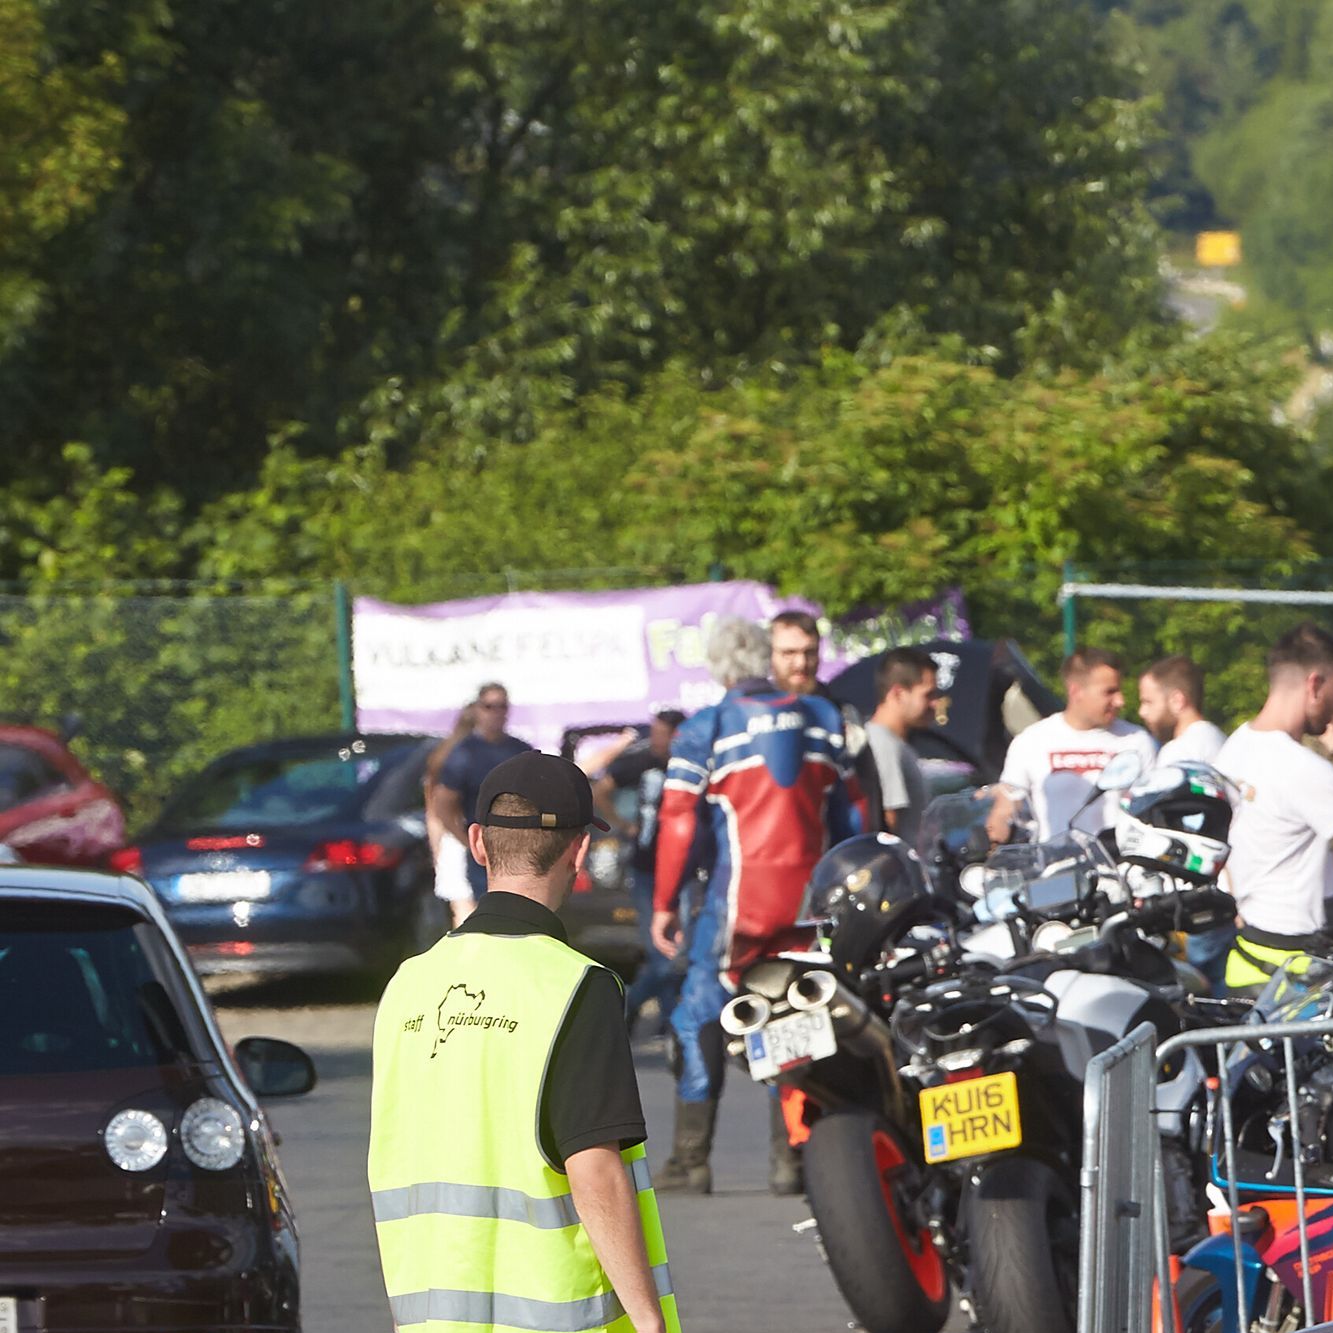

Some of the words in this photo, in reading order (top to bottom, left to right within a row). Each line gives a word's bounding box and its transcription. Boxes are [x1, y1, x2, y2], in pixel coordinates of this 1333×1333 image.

[403, 1013, 425, 1033] staff
[447, 1012, 519, 1034] nürburgring
[931, 1081, 1005, 1120] KU16
[948, 1110, 1013, 1146] HRN
